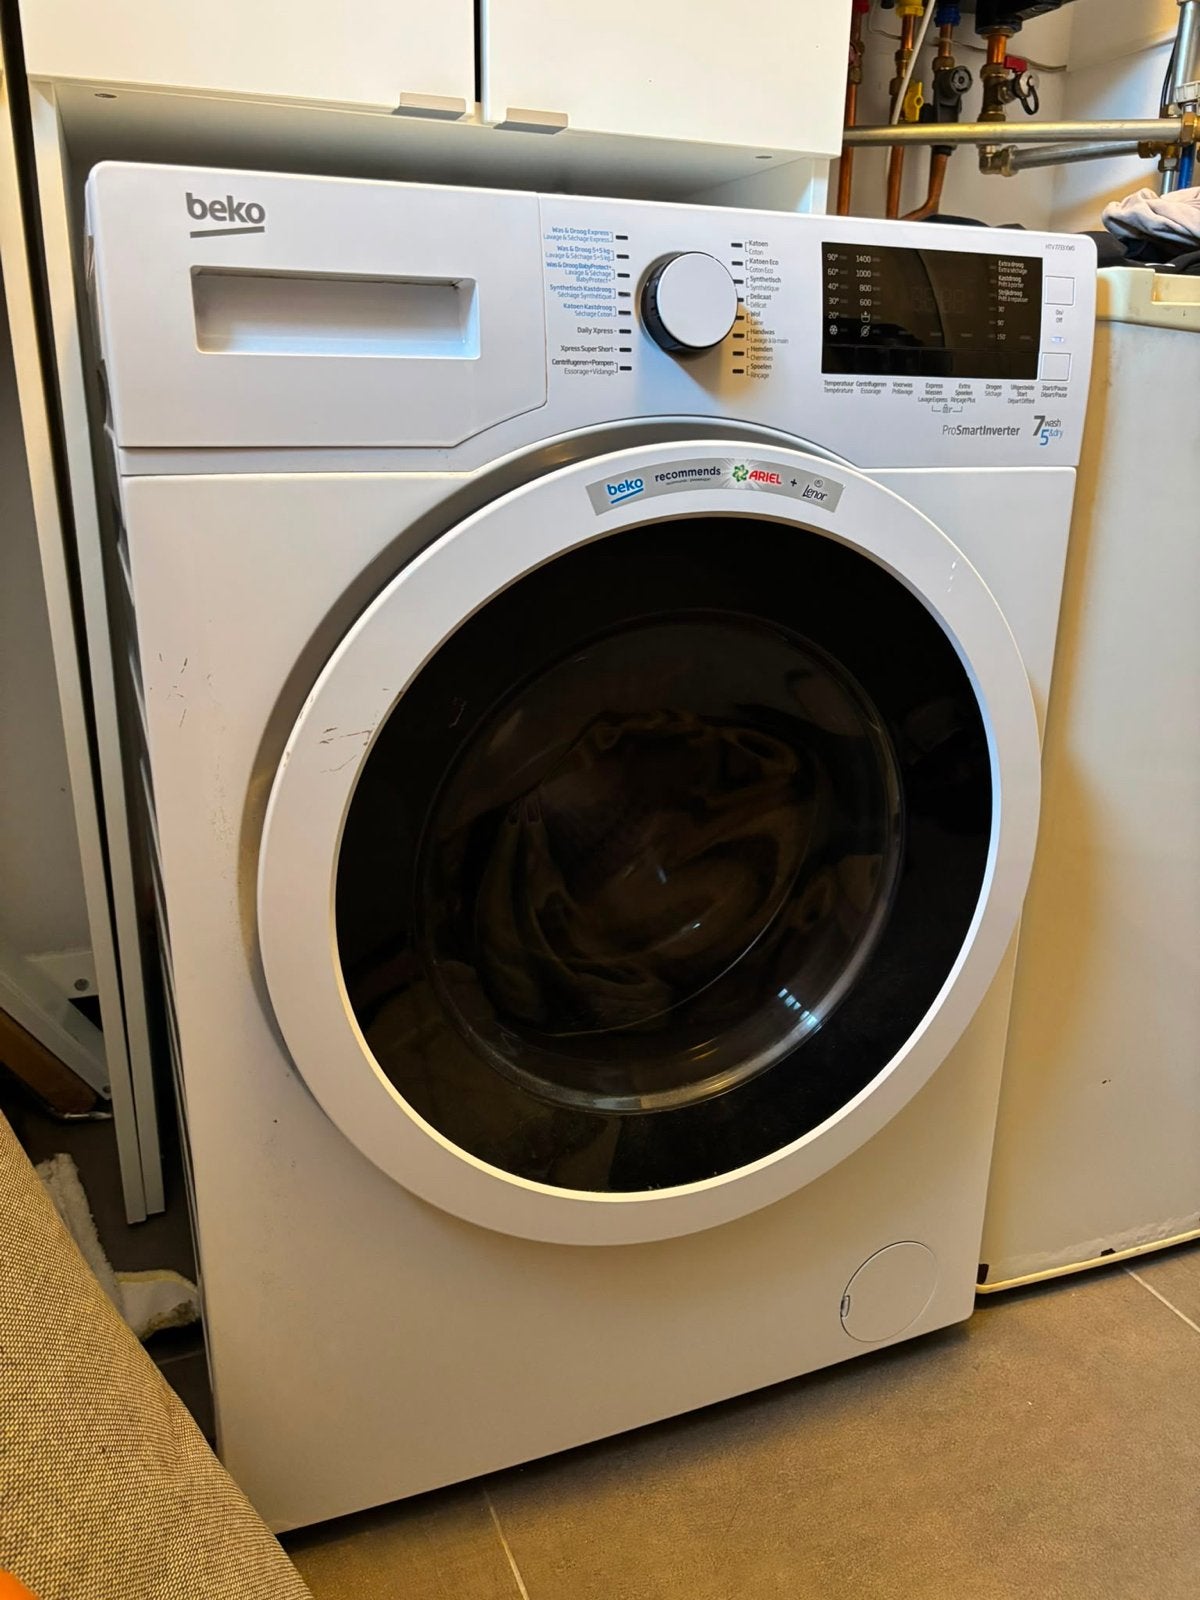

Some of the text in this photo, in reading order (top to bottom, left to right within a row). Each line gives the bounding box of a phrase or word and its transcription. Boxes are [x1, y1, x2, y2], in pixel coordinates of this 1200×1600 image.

[185, 191, 266, 224] beko
[570, 228, 587, 236] Droog
[574, 246, 592, 254] Droog
[545, 252, 564, 260] Lavage
[826, 253, 838, 261] 90°
[856, 254, 872, 263] 1400
[856, 270, 872, 278] 1000
[860, 284, 872, 292] 800
[828, 312, 839, 320] 20°
[1032, 415, 1062, 436] 7 wash
[942, 425, 1020, 436] ProSmartInverter
[1040, 429, 1050, 446] 5
[606, 477, 644, 496] beko
[655, 466, 721, 482] recommends
[748, 470, 782, 485] ARIEL
[802, 484, 828, 501] Lenor
